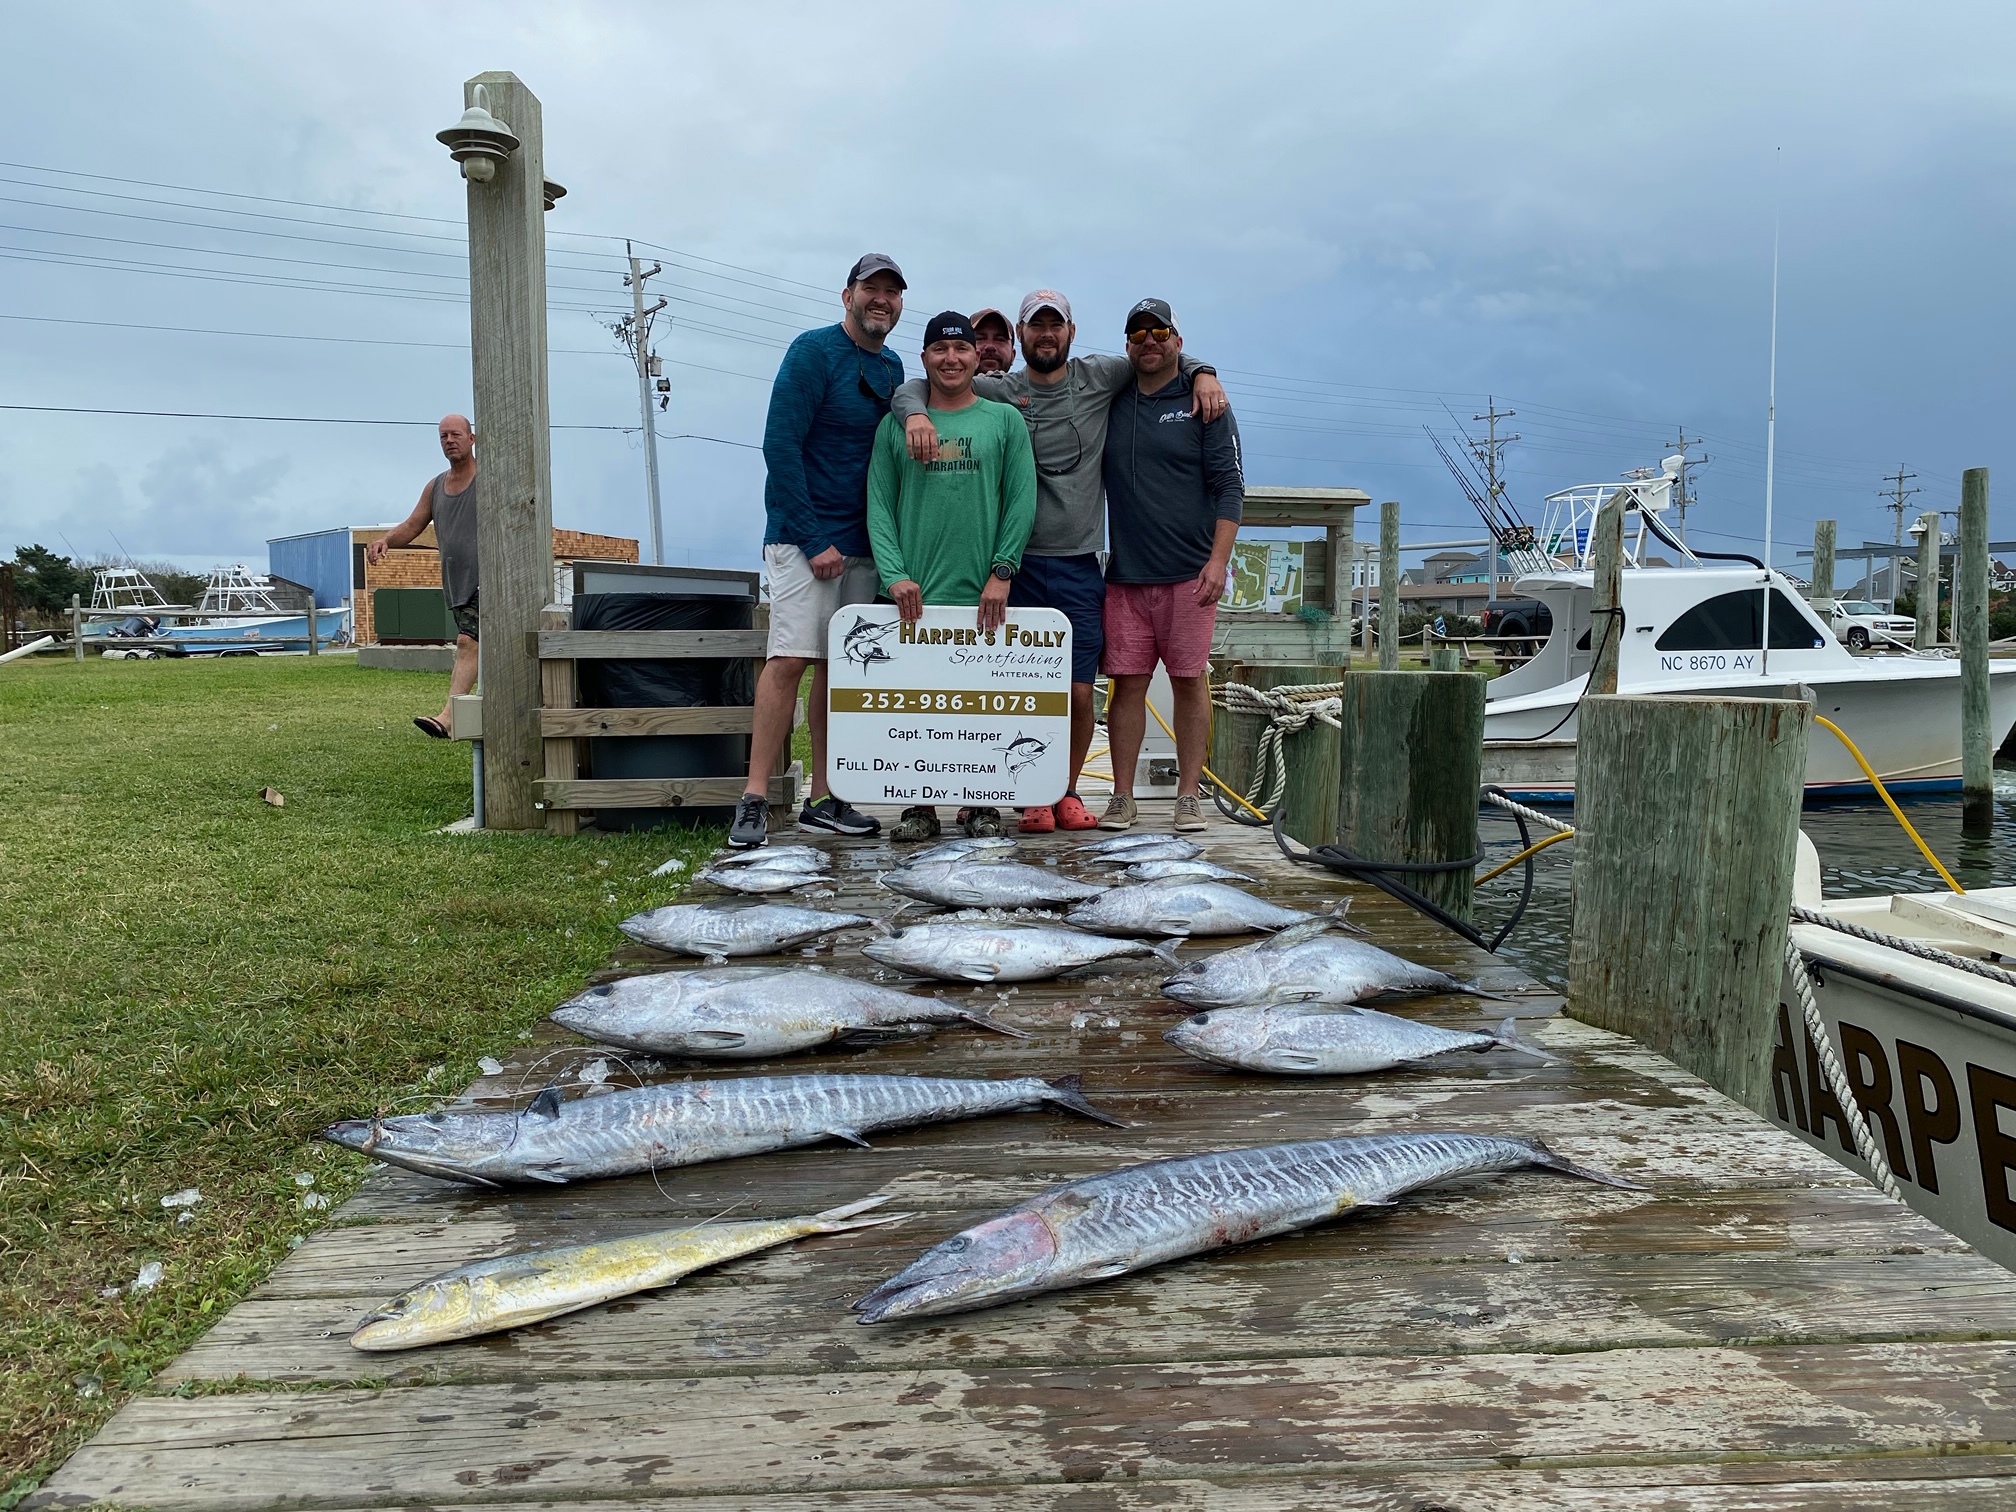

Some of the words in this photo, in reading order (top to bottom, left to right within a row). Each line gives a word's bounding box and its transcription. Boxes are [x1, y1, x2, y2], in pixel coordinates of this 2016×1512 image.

[925, 460, 980, 472] MARATHON
[899, 622, 996, 646] HARPER'S
[1005, 623, 1067, 648] FOLLY
[949, 648, 1064, 669] Sportfishing
[1661, 656, 1683, 671] NC
[1689, 655, 1726, 671] 8670
[1733, 655, 1755, 670] AY
[991, 670, 1043, 679] HATTERAS,
[1046, 671, 1062, 679] NC
[861, 692, 1037, 712] 252-986-1078
[888, 727, 922, 742] Capt.
[926, 728, 954, 740] Tom
[958, 729, 1002, 743] Harper
[836, 757, 868, 771] FULL
[873, 758, 900, 772] DAY
[914, 759, 996, 774] GULFSTREAM
[884, 785, 917, 799] HALF
[922, 786, 948, 800] DAY
[962, 787, 1016, 801] INSHORE
